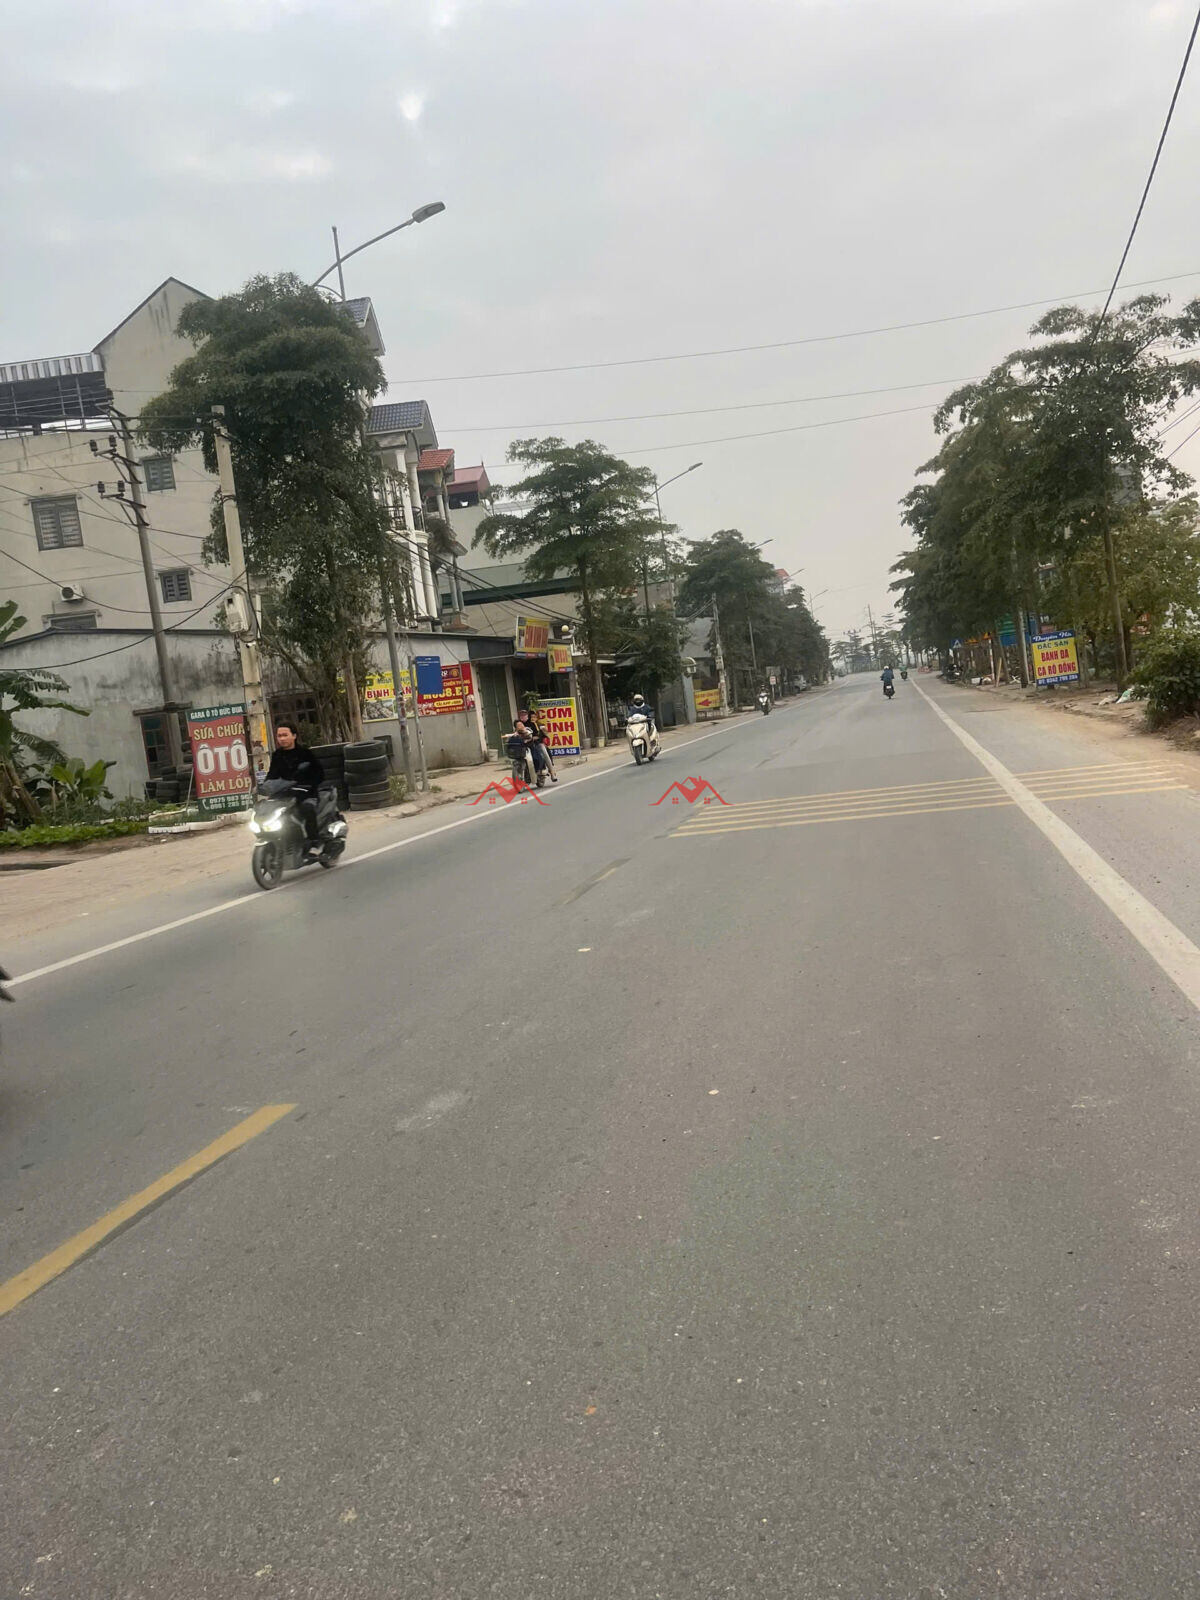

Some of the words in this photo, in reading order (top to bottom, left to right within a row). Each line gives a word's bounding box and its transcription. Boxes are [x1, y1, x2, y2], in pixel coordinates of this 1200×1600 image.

[537, 707, 572, 720] CƠM
[194, 725, 214, 740] SỬA
[547, 721, 575, 733] ÌNH
[197, 739, 249, 775] ÔTÔ
[200, 779, 225, 794] LÀM
